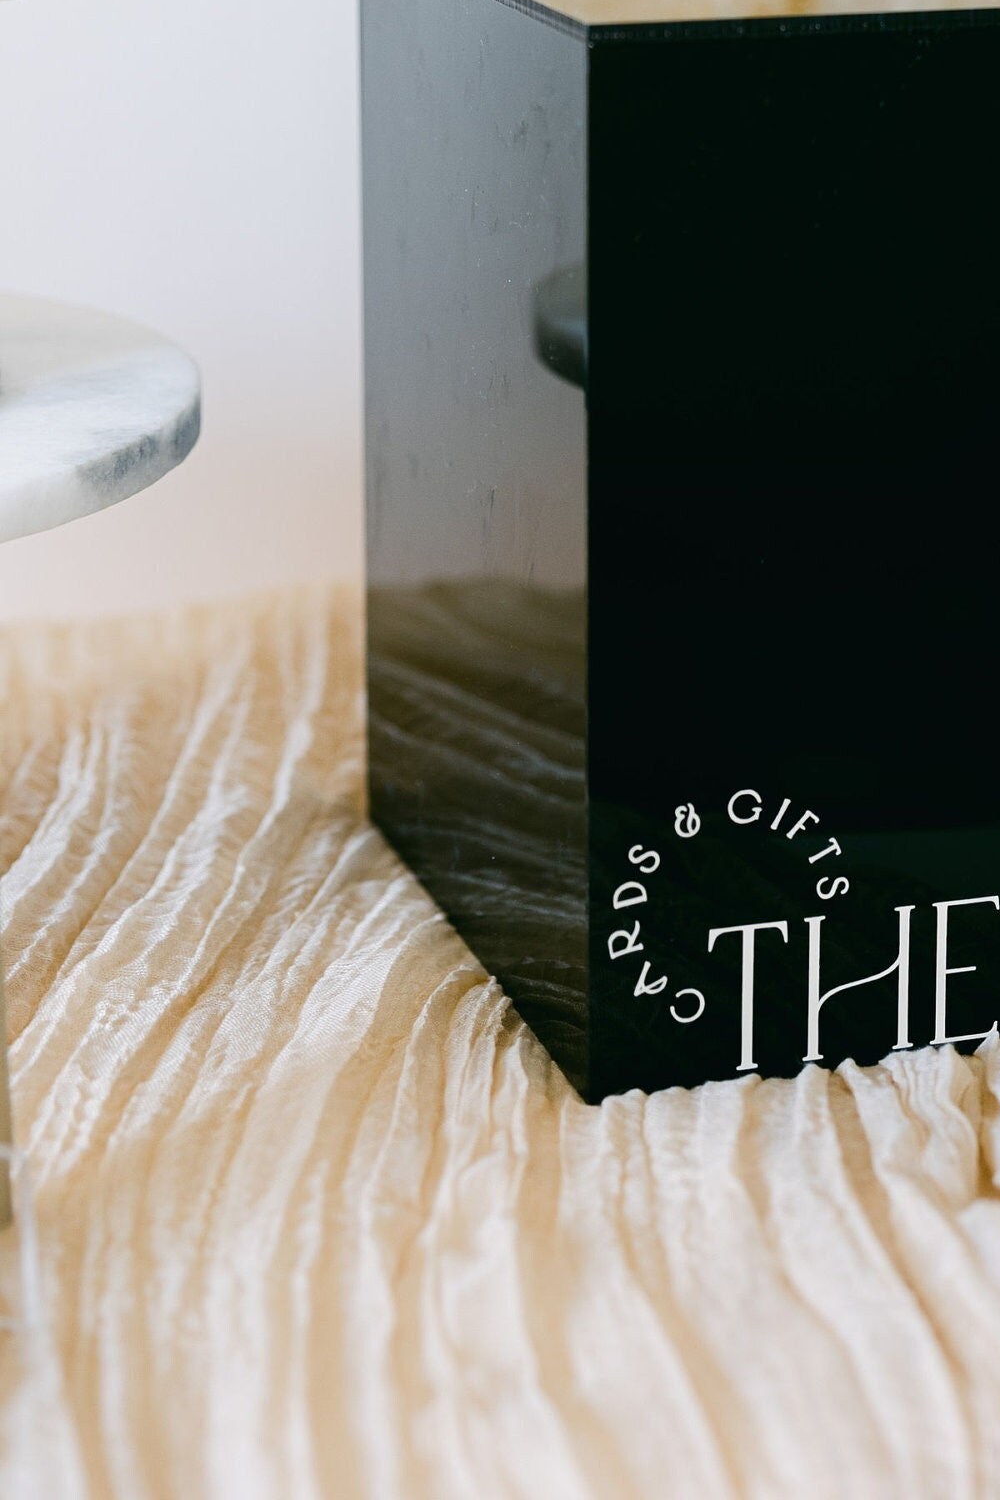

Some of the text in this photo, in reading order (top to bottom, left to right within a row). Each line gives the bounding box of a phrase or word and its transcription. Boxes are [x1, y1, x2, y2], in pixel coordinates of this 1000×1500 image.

[606, 788, 850, 1025] CARDS & GIFTS
[707, 895, 1000, 1071] THE
